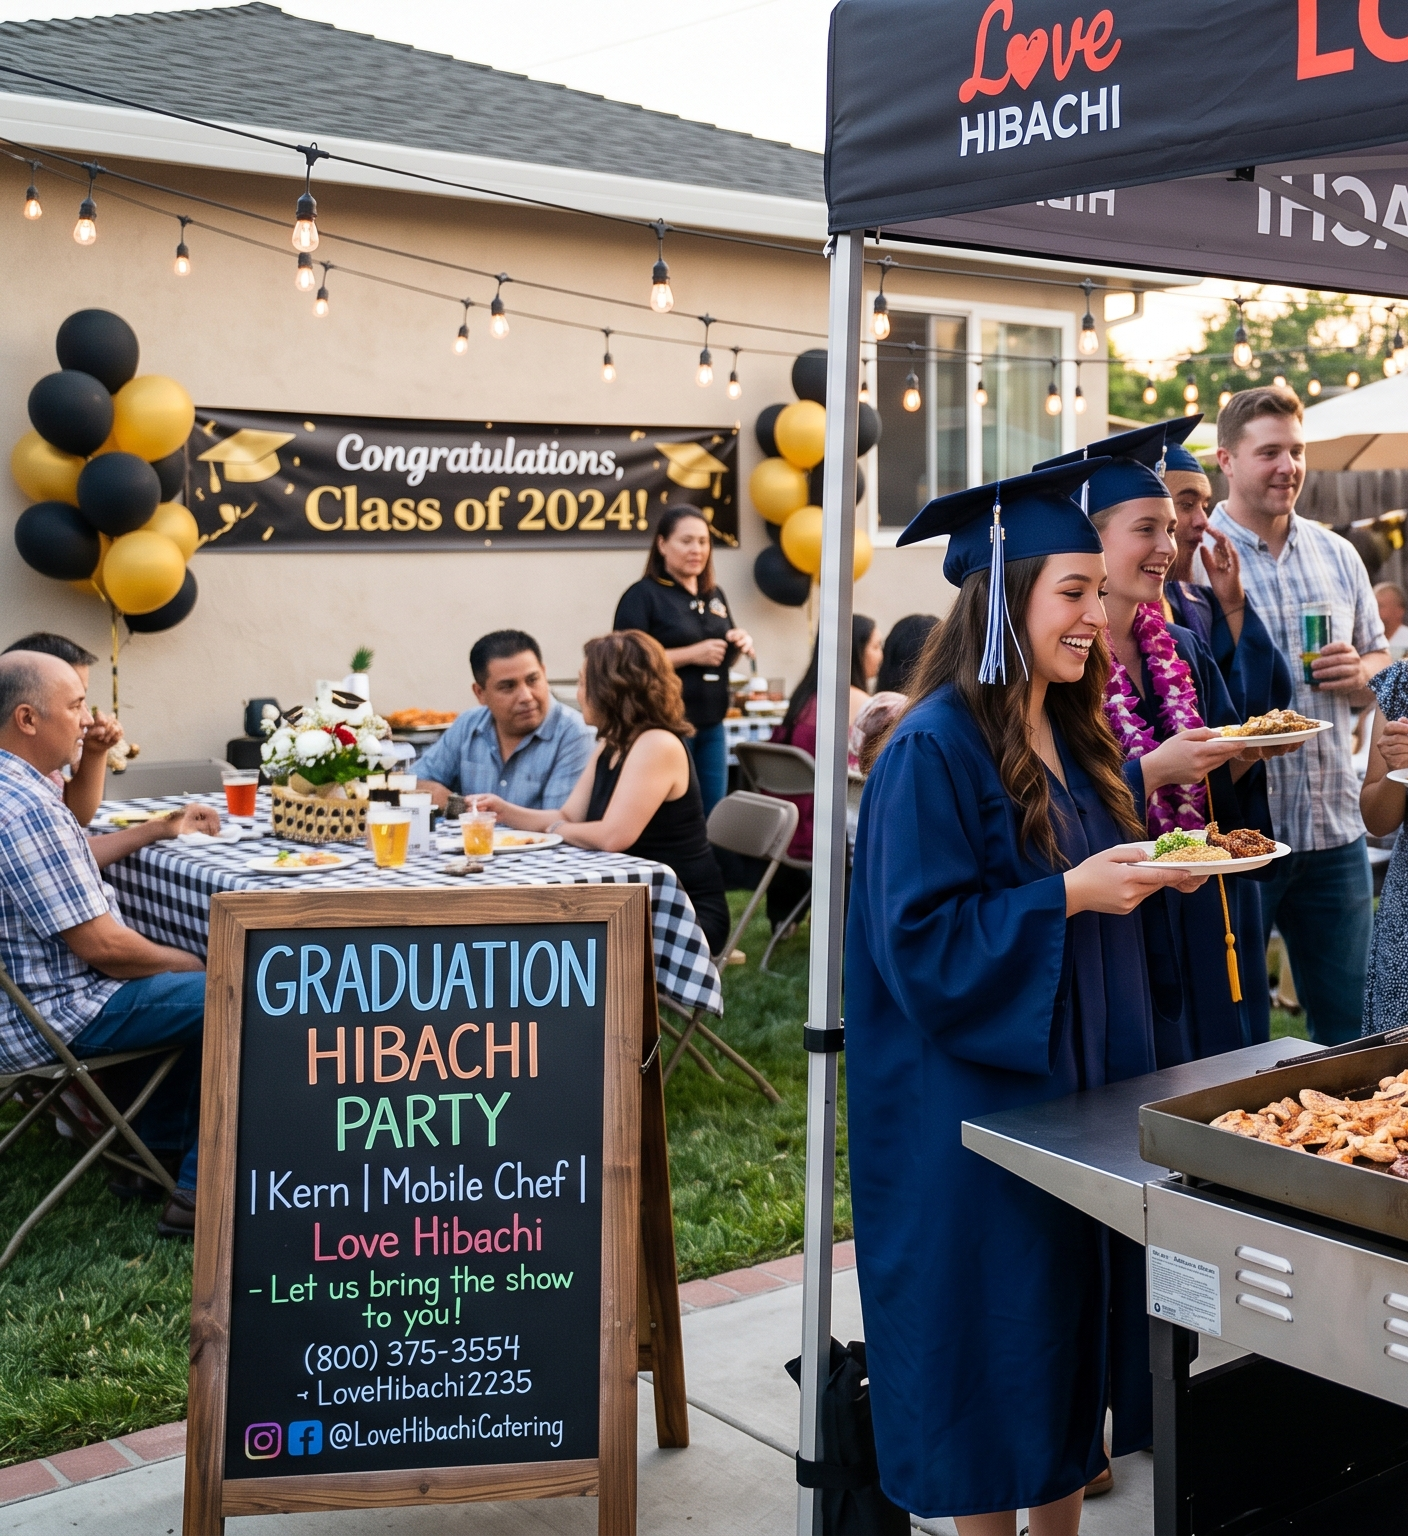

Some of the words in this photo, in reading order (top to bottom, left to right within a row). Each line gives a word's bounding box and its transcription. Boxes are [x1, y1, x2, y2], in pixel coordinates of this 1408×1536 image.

[958, 0, 1122, 103] Love
[960, 84, 1120, 157] HIBACHI
[336, 433, 625, 487] Congratulations,
[305, 485, 443, 532] Class
[454, 486, 511, 532] of
[517, 488, 649, 532] 2024!
[256, 938, 597, 1017] GRADUATION
[308, 1022, 539, 1085] HIBACHI
[337, 1091, 512, 1152] PARTY
[269, 1170, 350, 1211] Kern
[383, 1164, 484, 1205] Mobile
[494, 1159, 570, 1201] Chef
[313, 1222, 400, 1262] Love
[413, 1212, 544, 1256] Hibachi
[270, 1274, 318, 1304] Let
[329, 1281, 359, 1300] us
[369, 1270, 440, 1305] bring
[450, 1265, 495, 1294] the
[505, 1263, 574, 1292] show
[362, 1303, 392, 1329] to
[403, 1298, 462, 1337] you!
[303, 1340, 379, 1376] (800)
[386, 1334, 521, 1366] 375-3554
[318, 1369, 533, 1406] LoveHibachi2235
[329, 1413, 564, 1450] @LoveHibachiCatering
